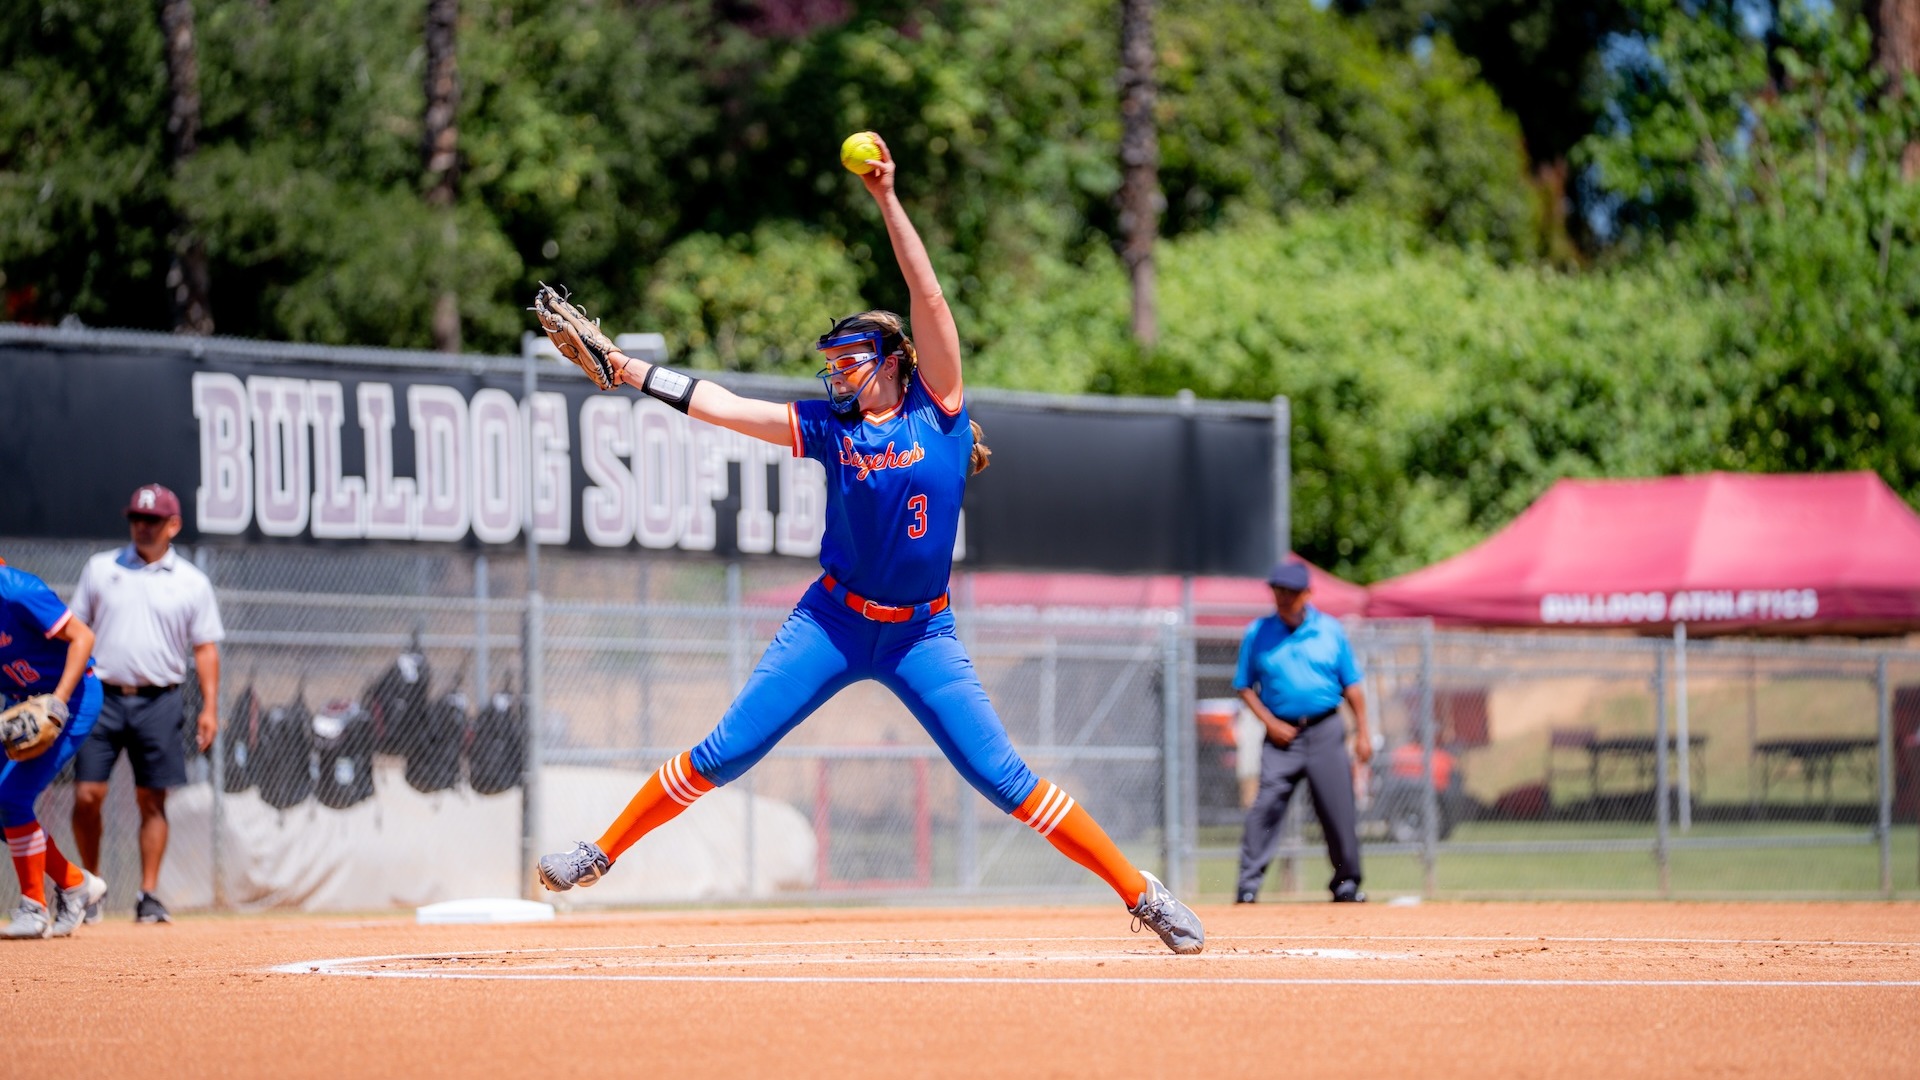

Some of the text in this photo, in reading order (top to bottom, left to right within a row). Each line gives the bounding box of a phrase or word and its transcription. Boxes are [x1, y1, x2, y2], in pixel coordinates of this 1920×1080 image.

[192, 371, 967, 561] BULLDOG SOFTB
[908, 493, 927, 539] 3
[1540, 588, 1819, 624] BULLDOG ATHLETICS
